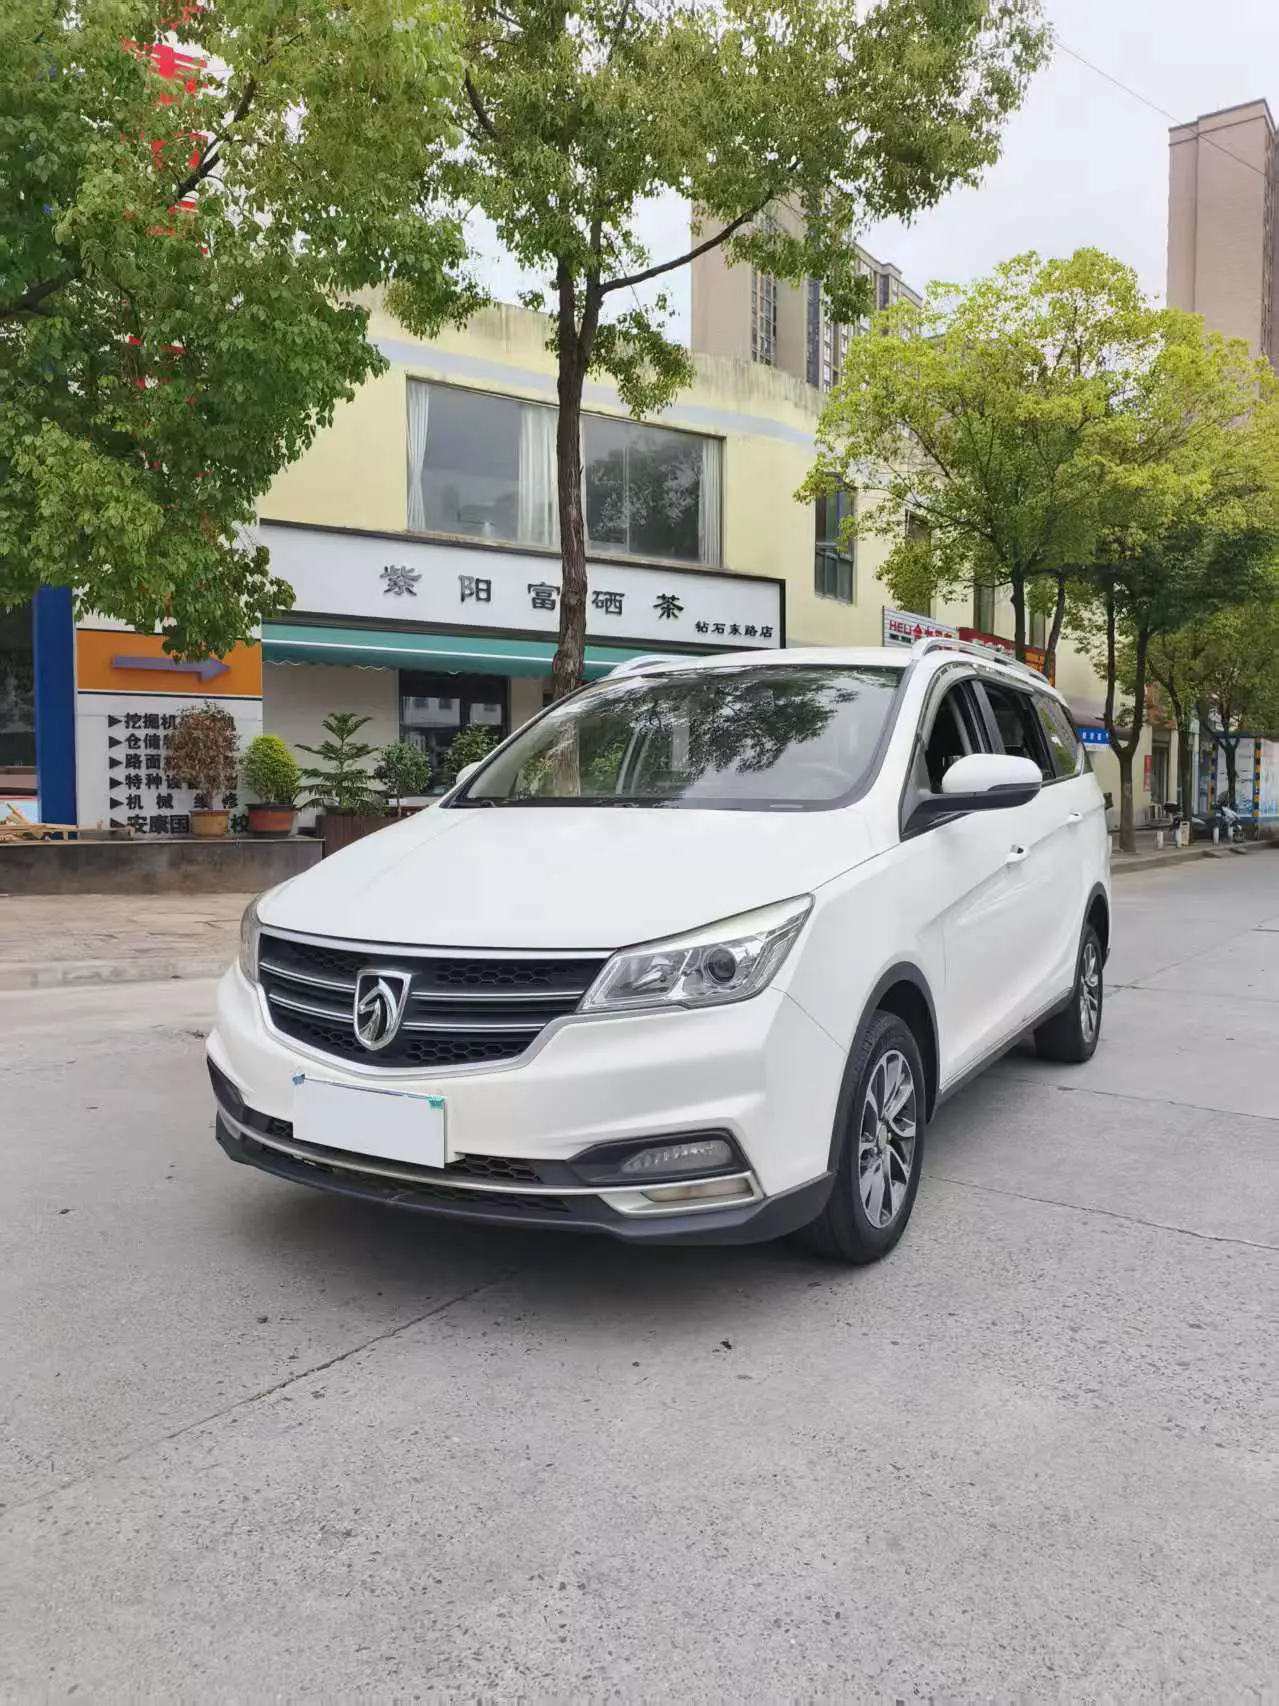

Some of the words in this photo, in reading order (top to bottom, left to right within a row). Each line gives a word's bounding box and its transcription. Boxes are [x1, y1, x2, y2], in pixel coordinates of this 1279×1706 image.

[379, 564, 684, 620] 紫阳富硒茶
[695, 620, 774, 638] 钻石东路店
[127, 814, 248, 833] 安康国校
